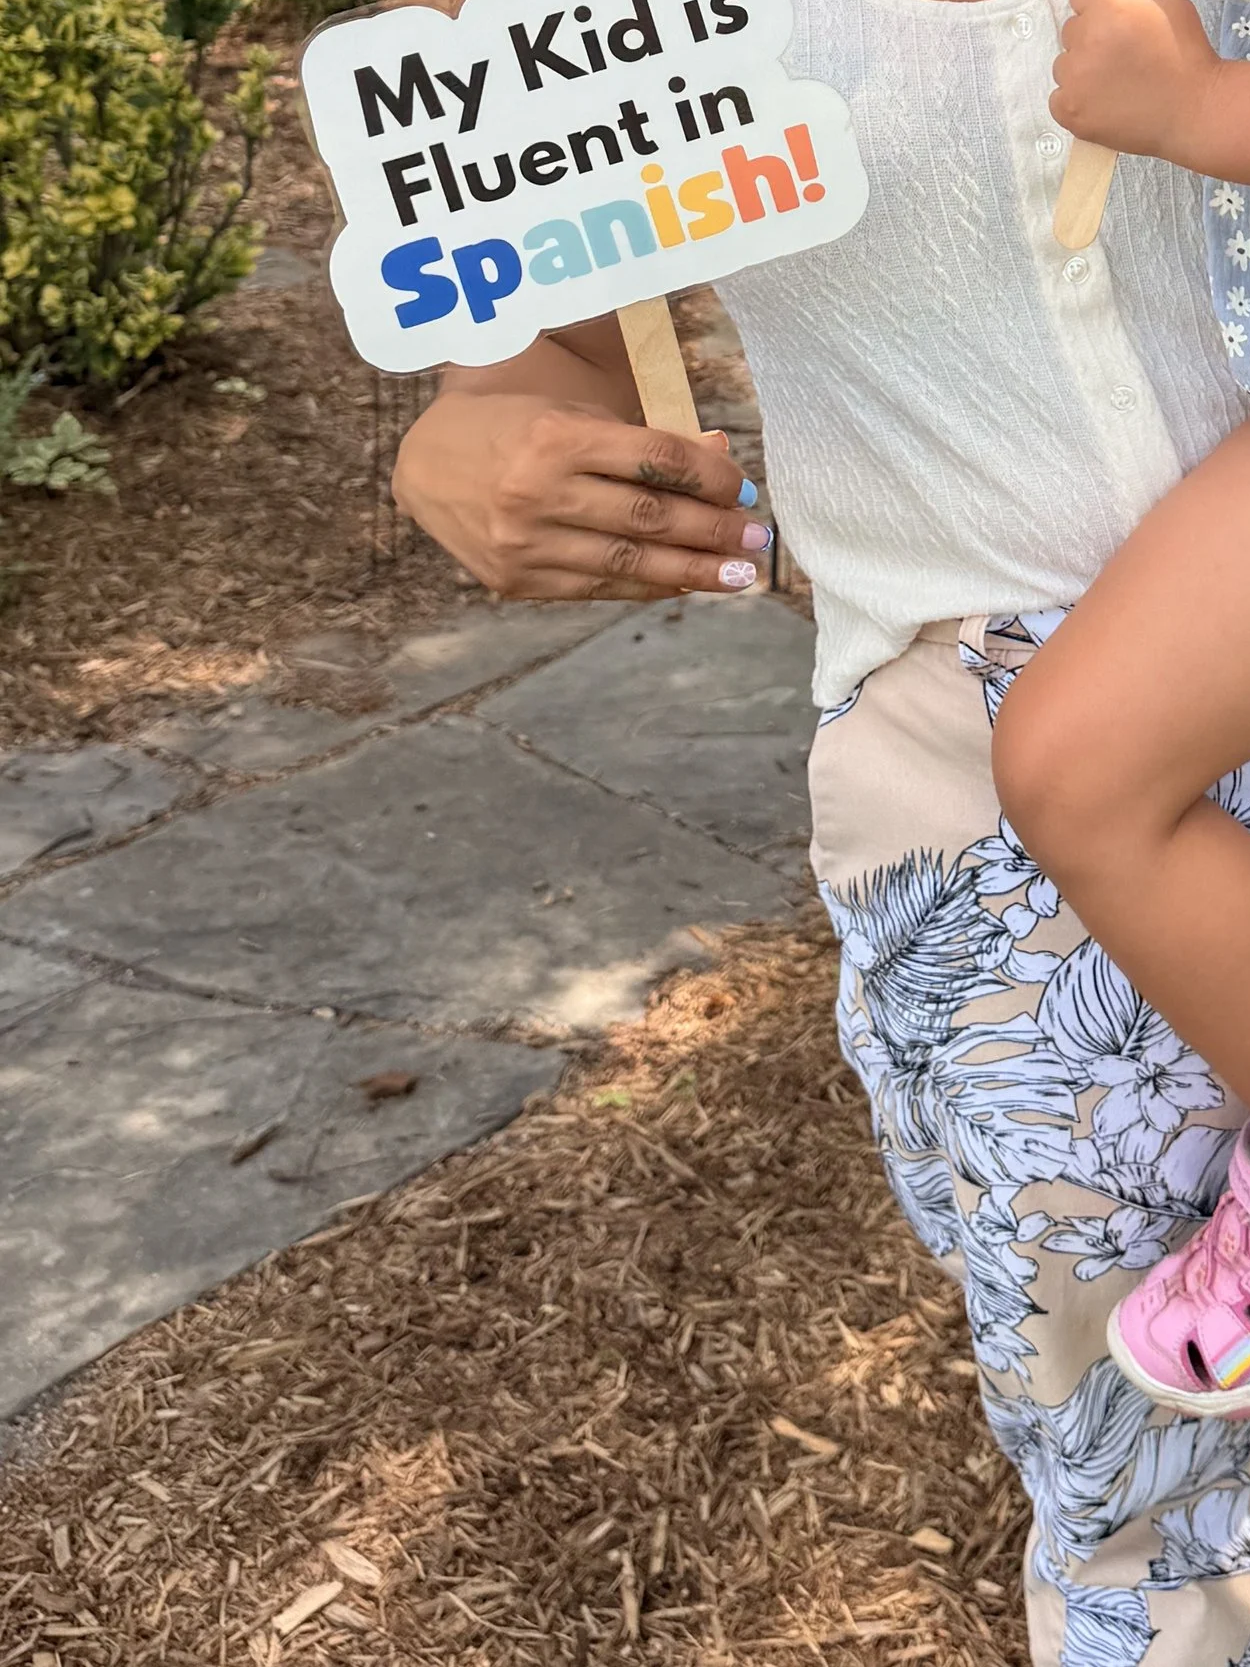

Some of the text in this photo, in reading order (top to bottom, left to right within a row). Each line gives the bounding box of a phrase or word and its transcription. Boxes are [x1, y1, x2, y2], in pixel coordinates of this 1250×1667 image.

[353, 52, 490, 137] My
[381, 76, 755, 227] Fluent in
[380, 123, 826, 330] Spanish!
